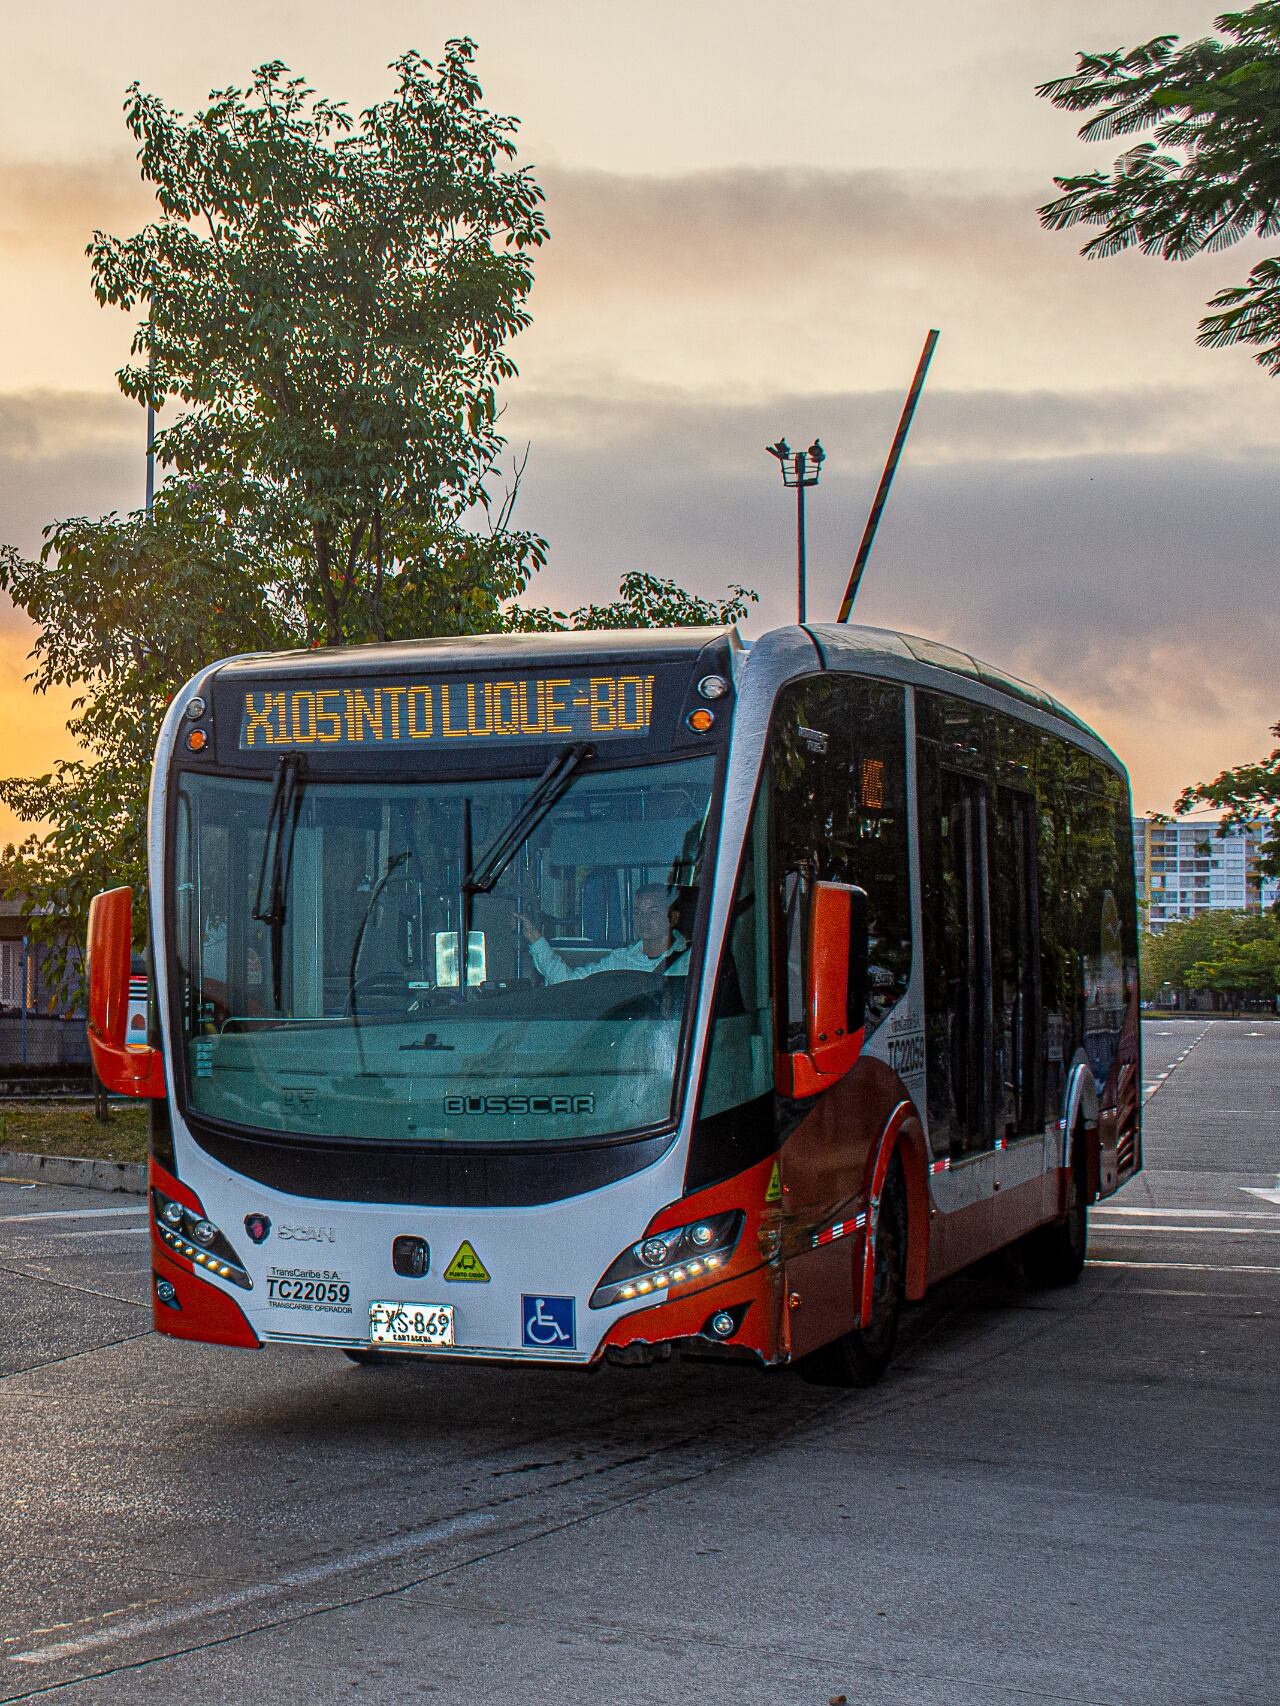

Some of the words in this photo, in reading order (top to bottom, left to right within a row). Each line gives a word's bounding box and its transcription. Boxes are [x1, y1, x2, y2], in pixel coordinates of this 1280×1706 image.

[444, 1095, 595, 1115] BUSSCAR
[271, 1267, 321, 1278] TransCaribe
[323, 1271, 341, 1280] S.A.
[267, 1279, 350, 1302] TC22059
[269, 1301, 314, 1311] TRANSCARIBE
[315, 1304, 352, 1313] OPERADOR
